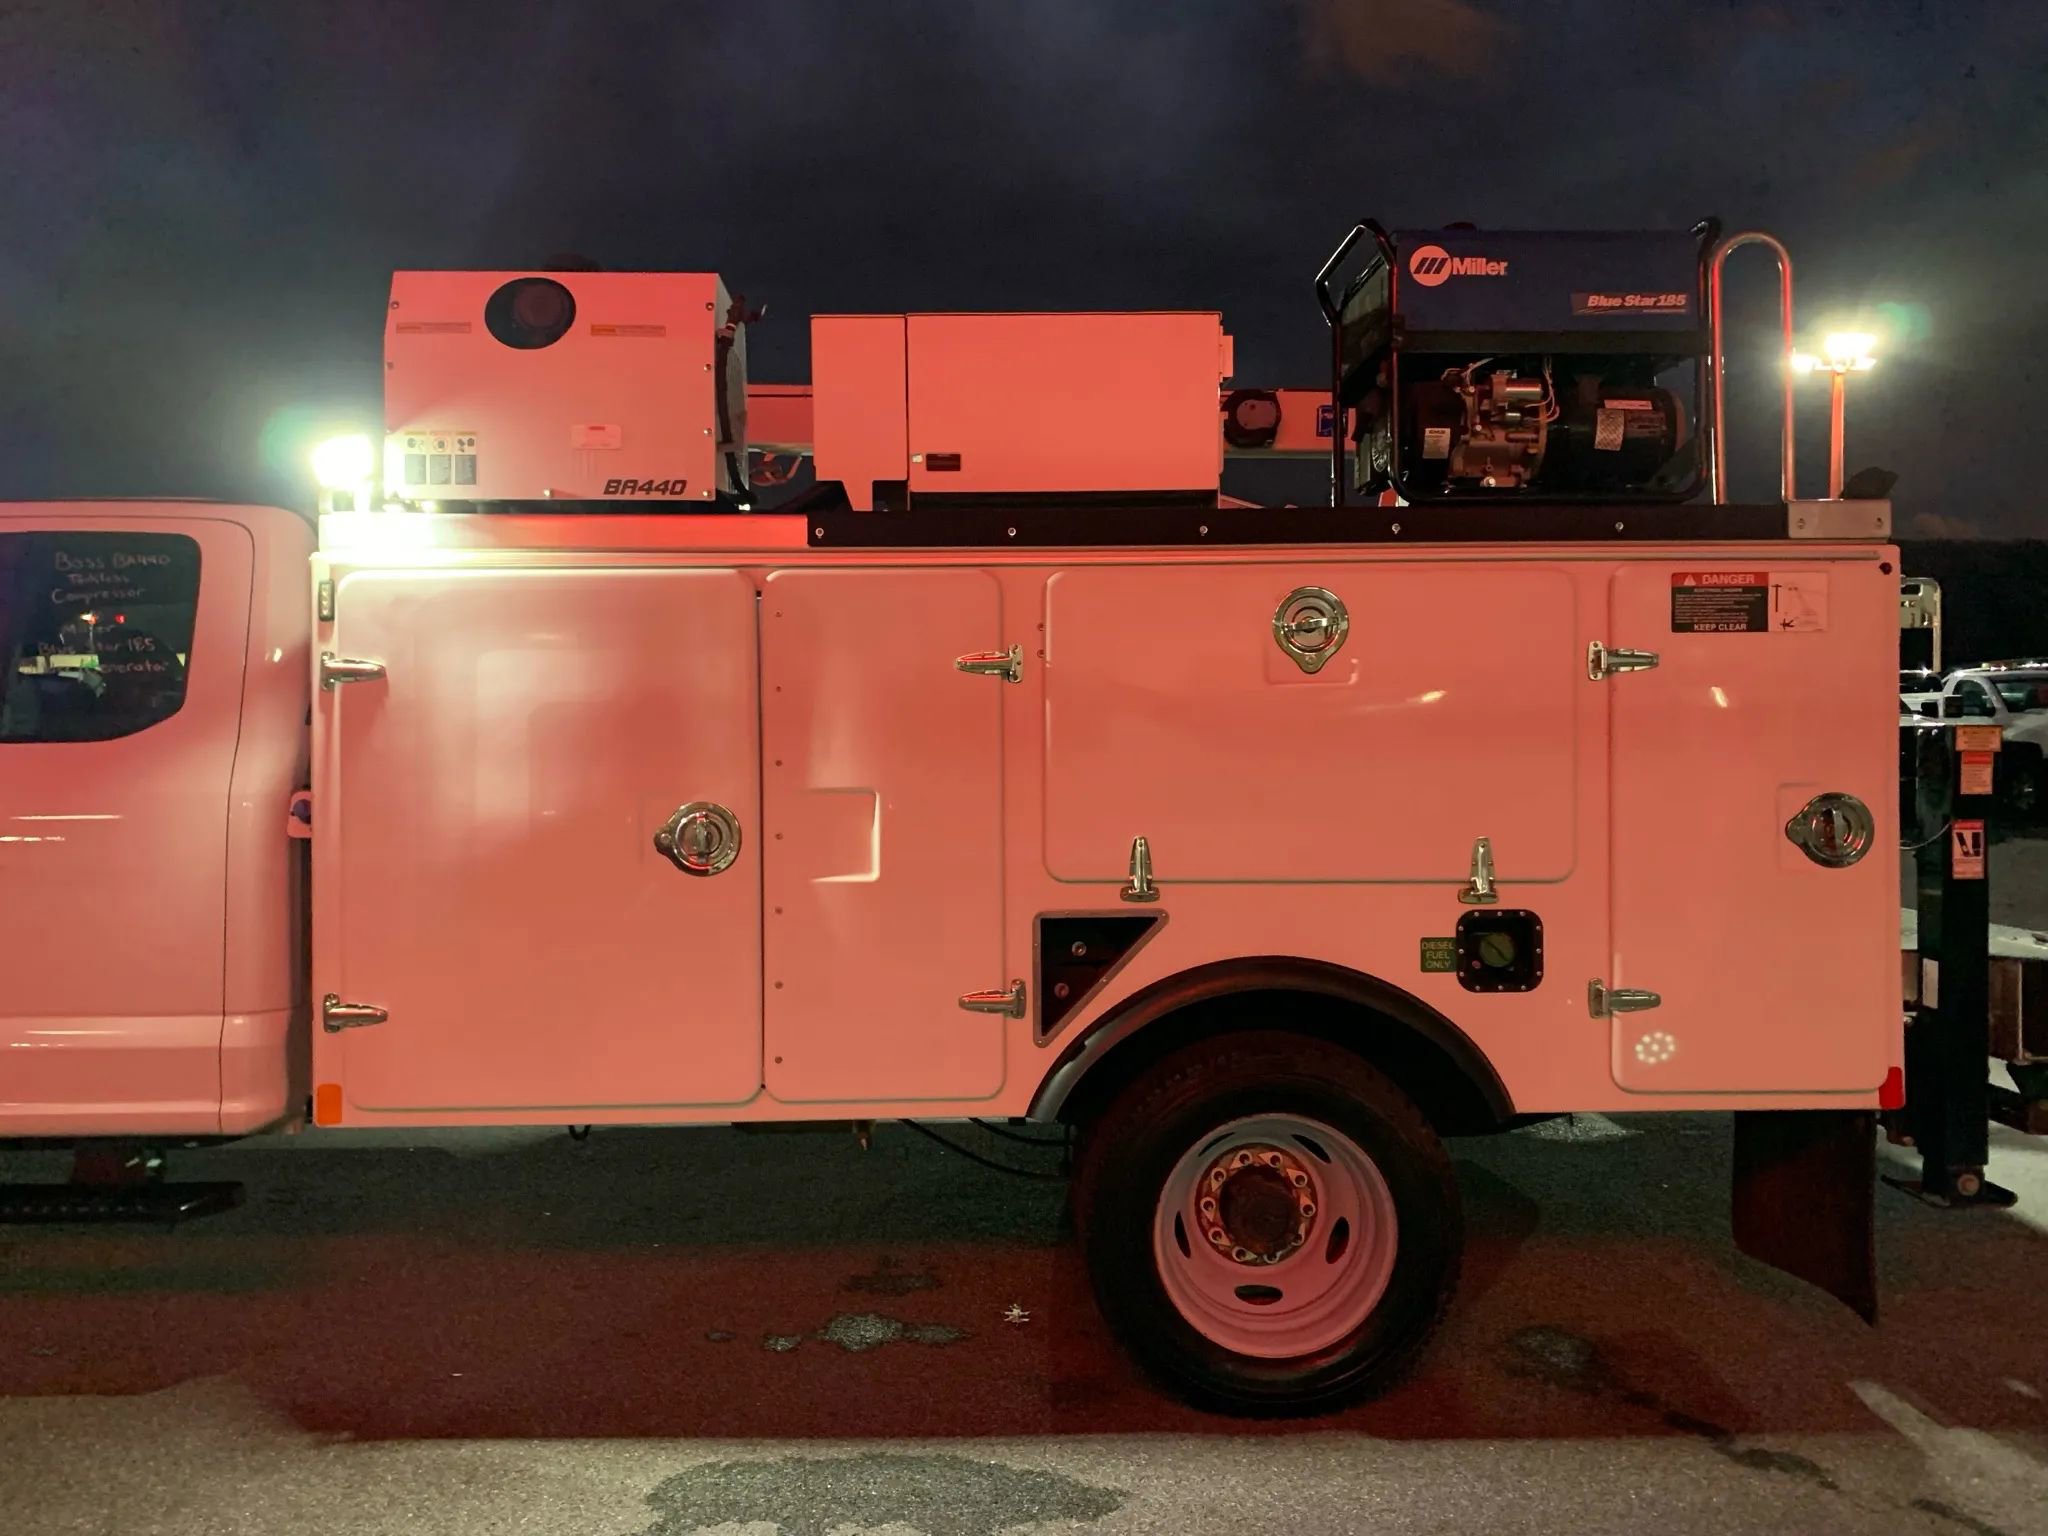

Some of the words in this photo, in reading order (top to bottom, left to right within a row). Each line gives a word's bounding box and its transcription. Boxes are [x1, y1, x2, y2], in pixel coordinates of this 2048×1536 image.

[1452, 257, 1508, 275] Miller
[1588, 295, 1622, 307] Blue
[1624, 294, 1657, 307] Star
[1657, 294, 1688, 306] 185
[603, 479, 688, 495] BA440
[55, 551, 105, 571] Boss
[1702, 574, 1755, 585] DANGER
[1693, 623, 1717, 631] KEEP
[1718, 623, 1747, 631] CLEAR
[92, 659, 169, 674] enerator
[1421, 941, 1455, 950] DIESEL
[1425, 951, 1450, 959] FUEL
[1425, 960, 1451, 969] ONLY
